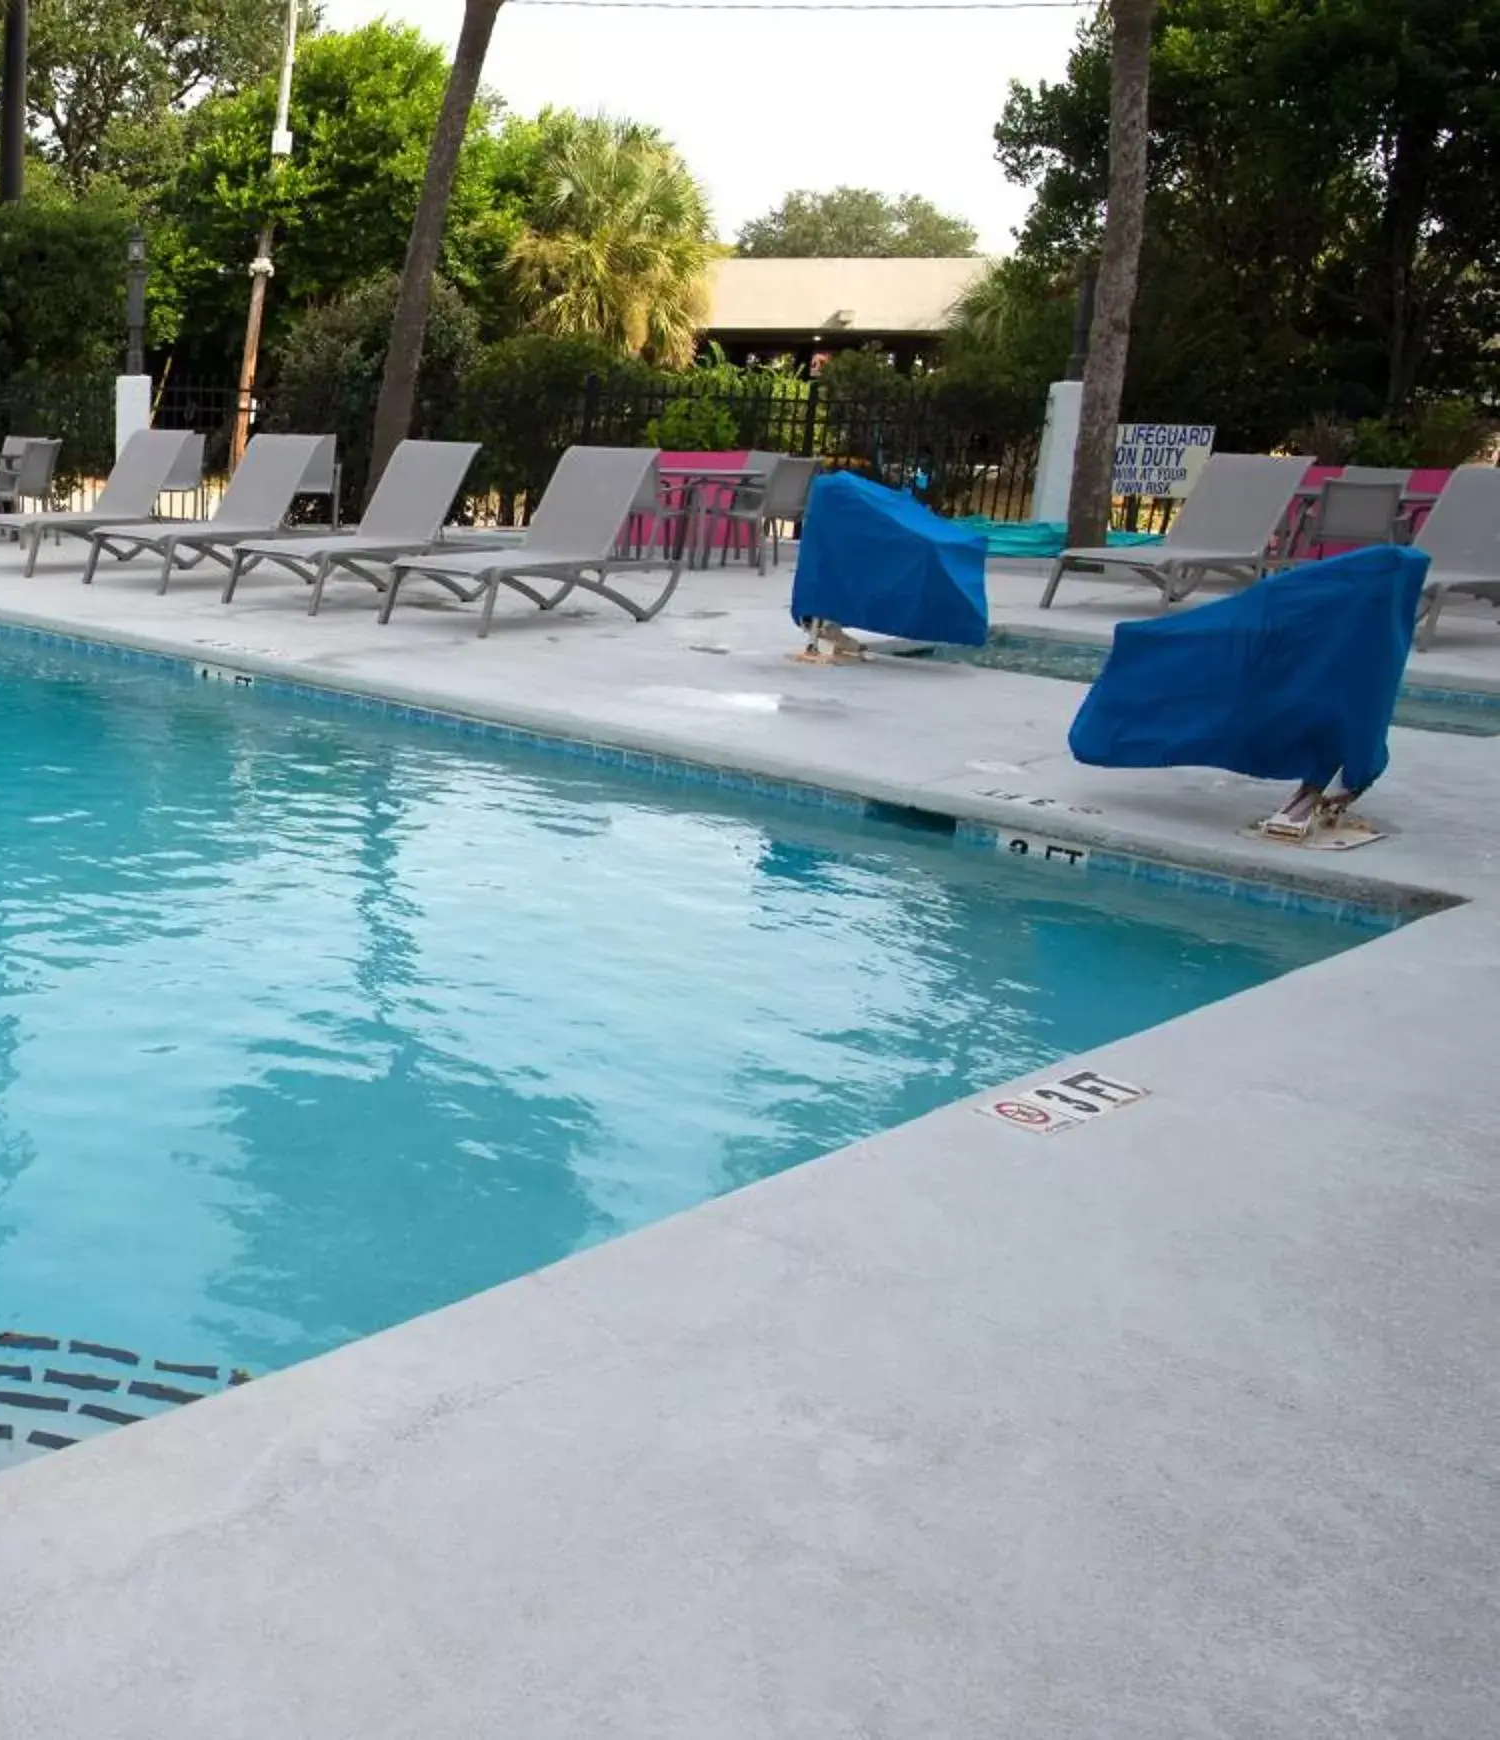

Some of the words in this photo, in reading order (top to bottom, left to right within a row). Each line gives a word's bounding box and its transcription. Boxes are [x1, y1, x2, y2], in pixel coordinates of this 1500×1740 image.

[1121, 425, 1212, 447] LIFEGUARD
[1115, 446, 1137, 466] ON
[1142, 446, 1185, 467] DUTY
[1139, 467, 1155, 481] AT
[1157, 468, 1188, 482] YOUR
[1146, 482, 1172, 496] RISK
[1060, 1071, 1141, 1103] FT
[1034, 1088, 1101, 1113] 3
